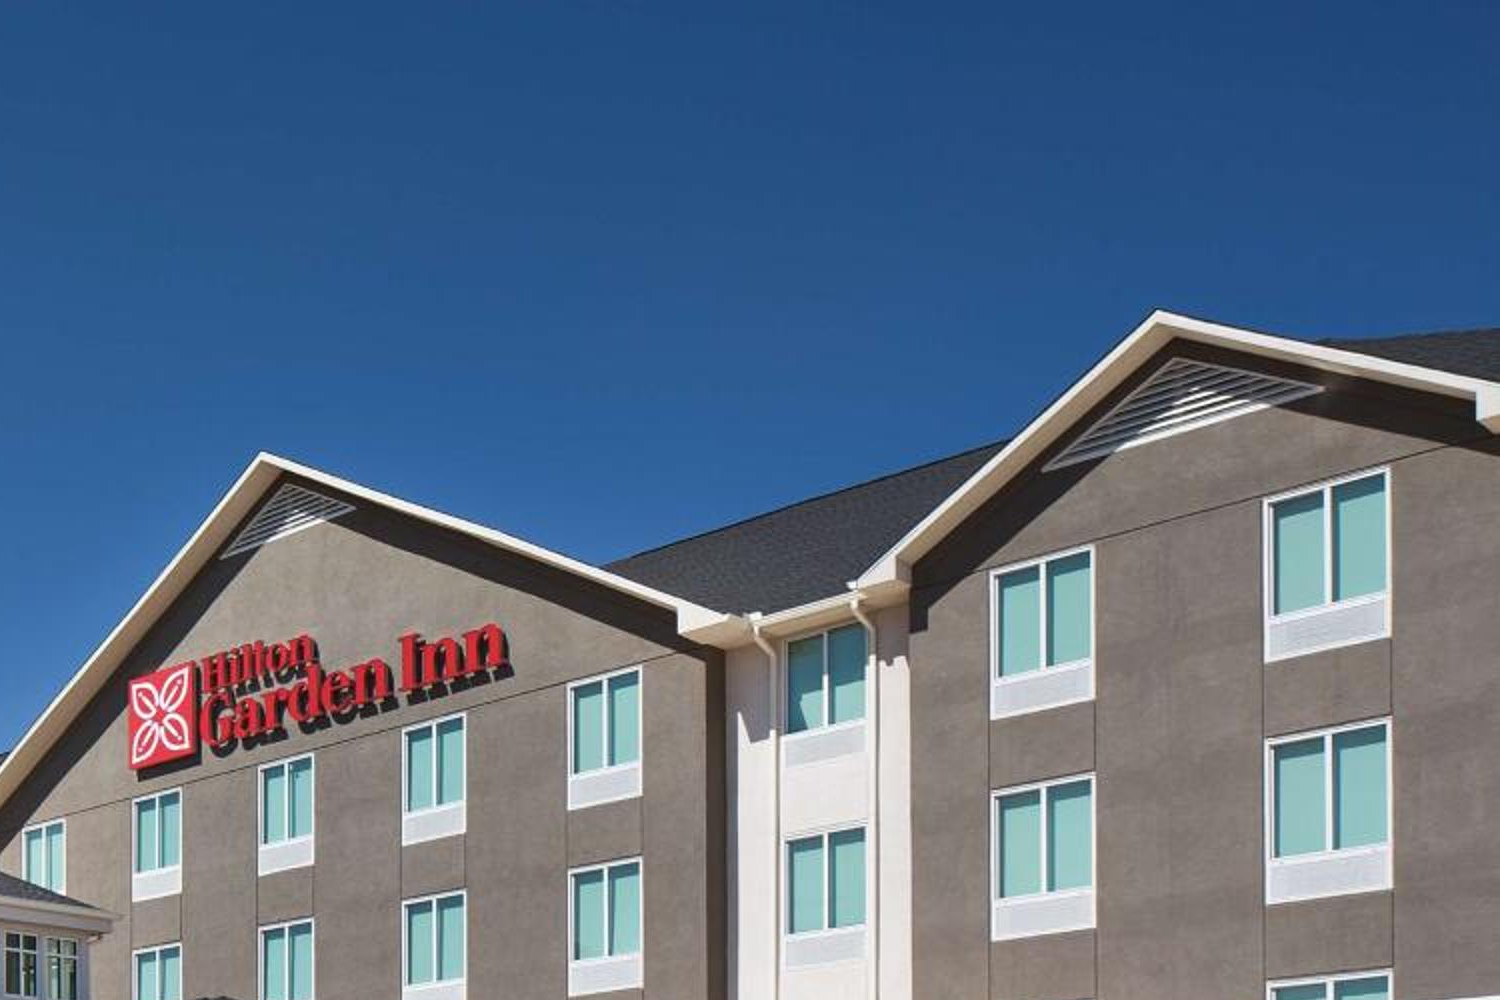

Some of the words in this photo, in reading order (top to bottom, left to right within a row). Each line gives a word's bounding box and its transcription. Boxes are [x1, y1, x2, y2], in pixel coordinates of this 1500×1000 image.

[199, 657, 390, 747] Garden
[398, 622, 505, 692] Inn
[200, 634, 315, 694] Hilton
